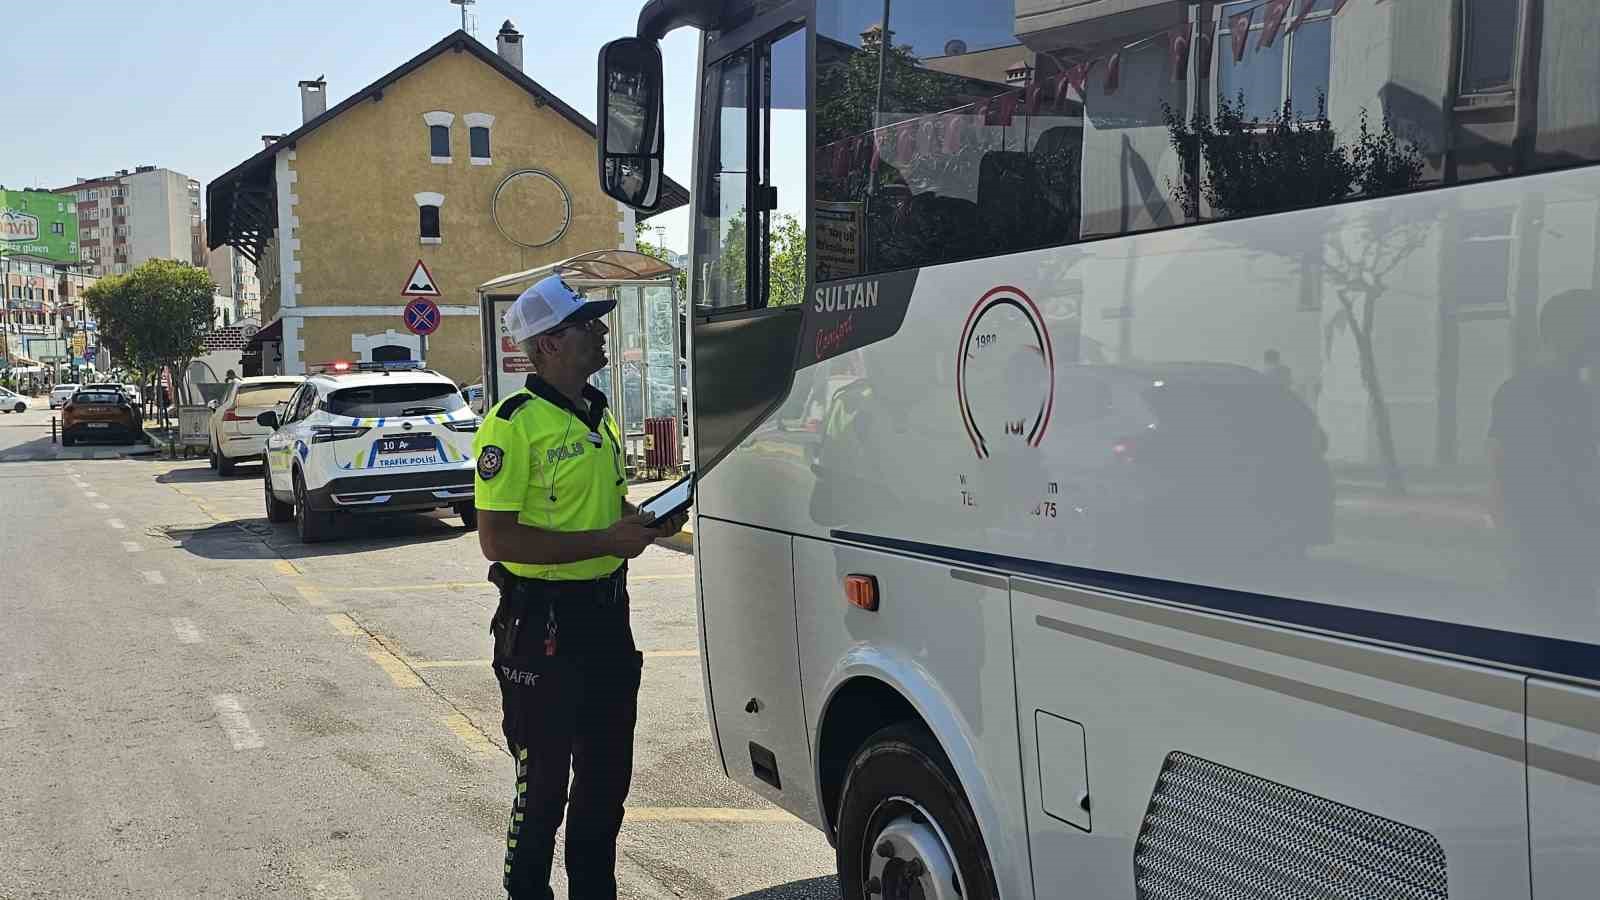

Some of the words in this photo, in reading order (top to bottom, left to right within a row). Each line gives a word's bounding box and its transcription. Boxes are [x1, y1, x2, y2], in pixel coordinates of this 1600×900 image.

[815, 281, 879, 312] SULTAN
[383, 441, 395, 450] 10
[1044, 502, 1057, 518] 75
